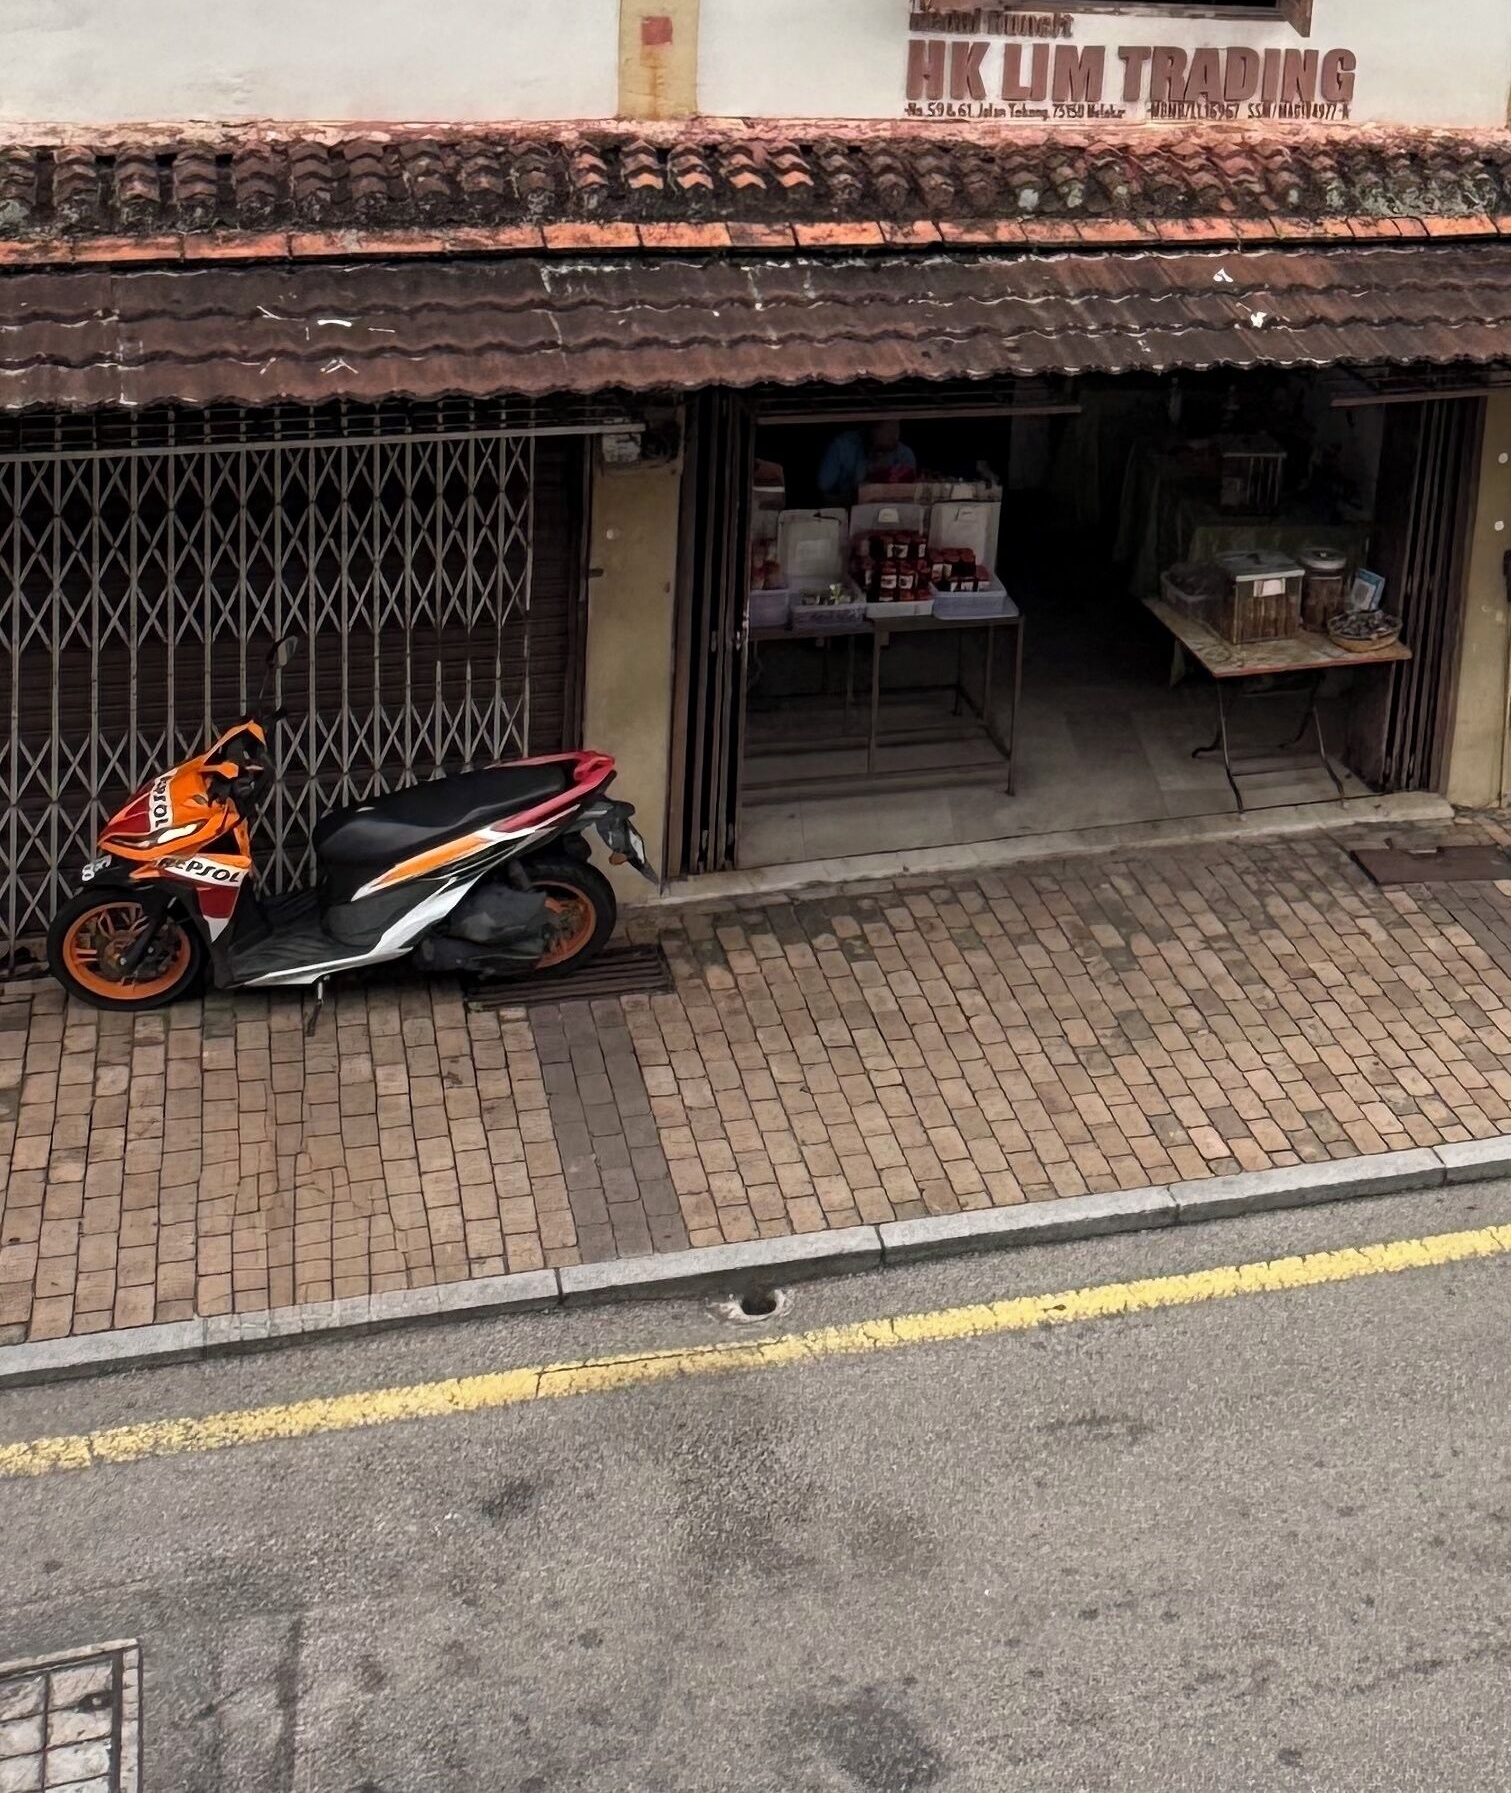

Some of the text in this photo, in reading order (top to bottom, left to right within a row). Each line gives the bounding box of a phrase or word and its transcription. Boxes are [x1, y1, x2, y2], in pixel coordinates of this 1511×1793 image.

[906, 39, 1357, 103] HK LIM TRADING
